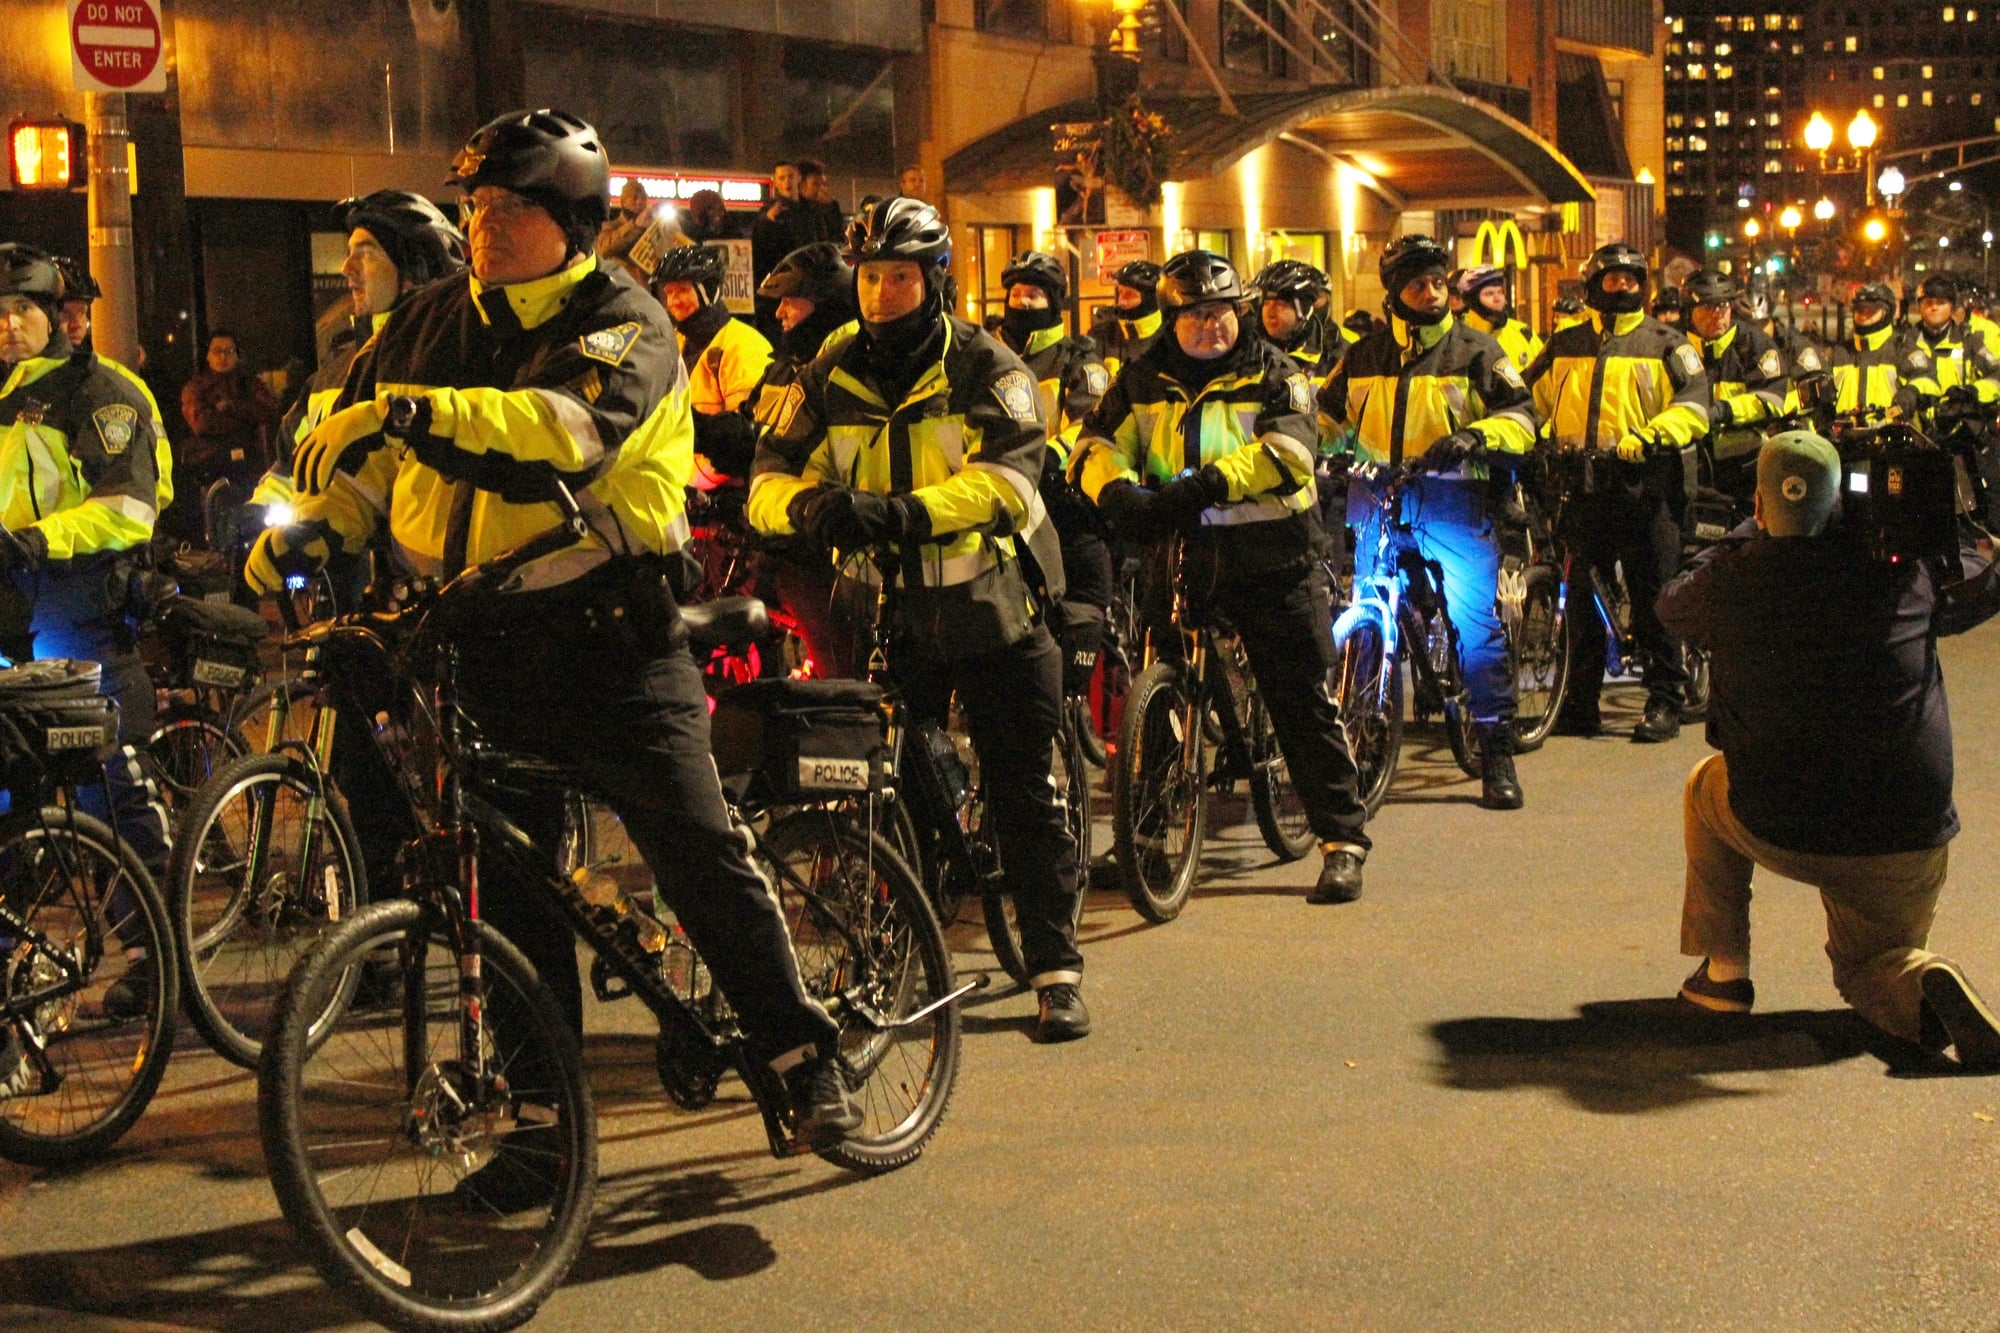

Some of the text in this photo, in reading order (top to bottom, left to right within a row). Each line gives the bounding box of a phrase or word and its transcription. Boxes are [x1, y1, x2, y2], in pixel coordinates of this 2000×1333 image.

[87, 3, 143, 23] DO NOT
[94, 50, 142, 69] ENTER
[722, 273, 749, 299] STICE
[50, 730, 101, 749] POLICE
[814, 764, 860, 784] POLICE
